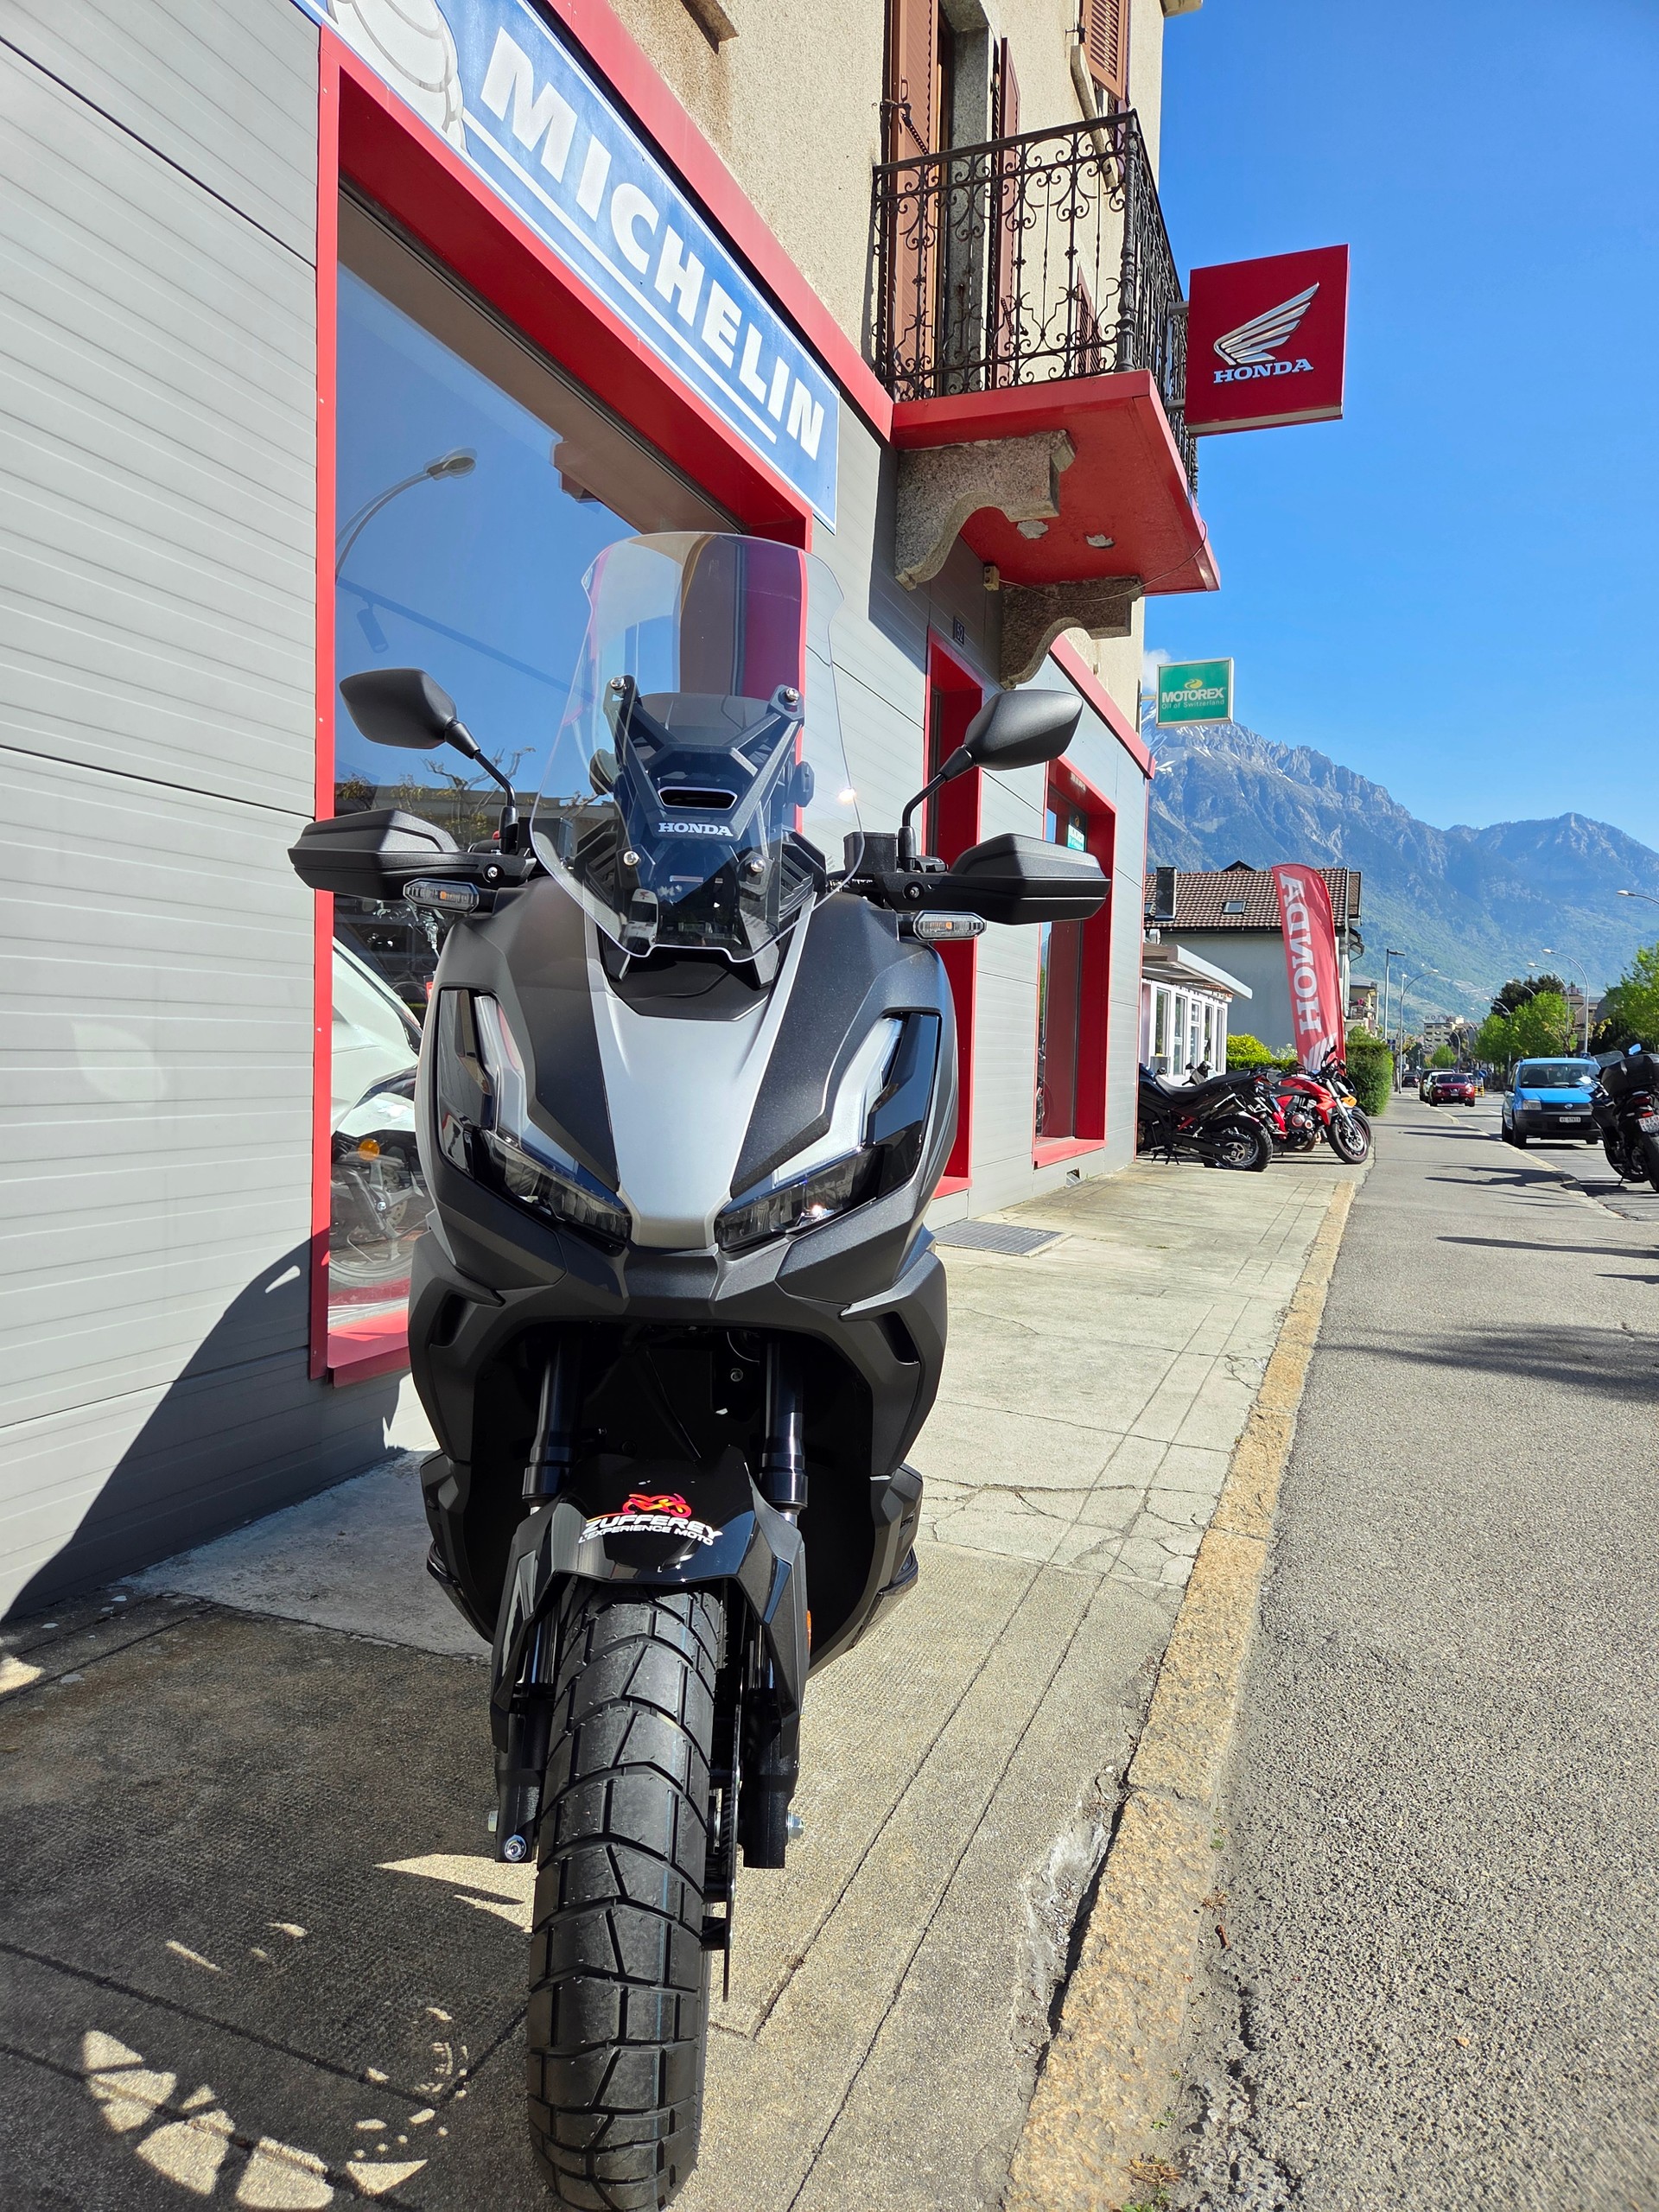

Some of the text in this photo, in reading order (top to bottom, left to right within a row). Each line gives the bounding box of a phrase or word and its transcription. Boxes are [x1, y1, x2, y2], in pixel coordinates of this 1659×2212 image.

[480, 27, 825, 461] MICHELIN
[1213, 359, 1313, 384] HONDA
[1162, 688, 1224, 702] MOTOREX
[1183, 699, 1224, 708] Switzerland
[658, 823, 734, 837] HONDA
[582, 1514, 723, 1540] ZUFFEREY
[675, 1528, 714, 1546] MOTO
